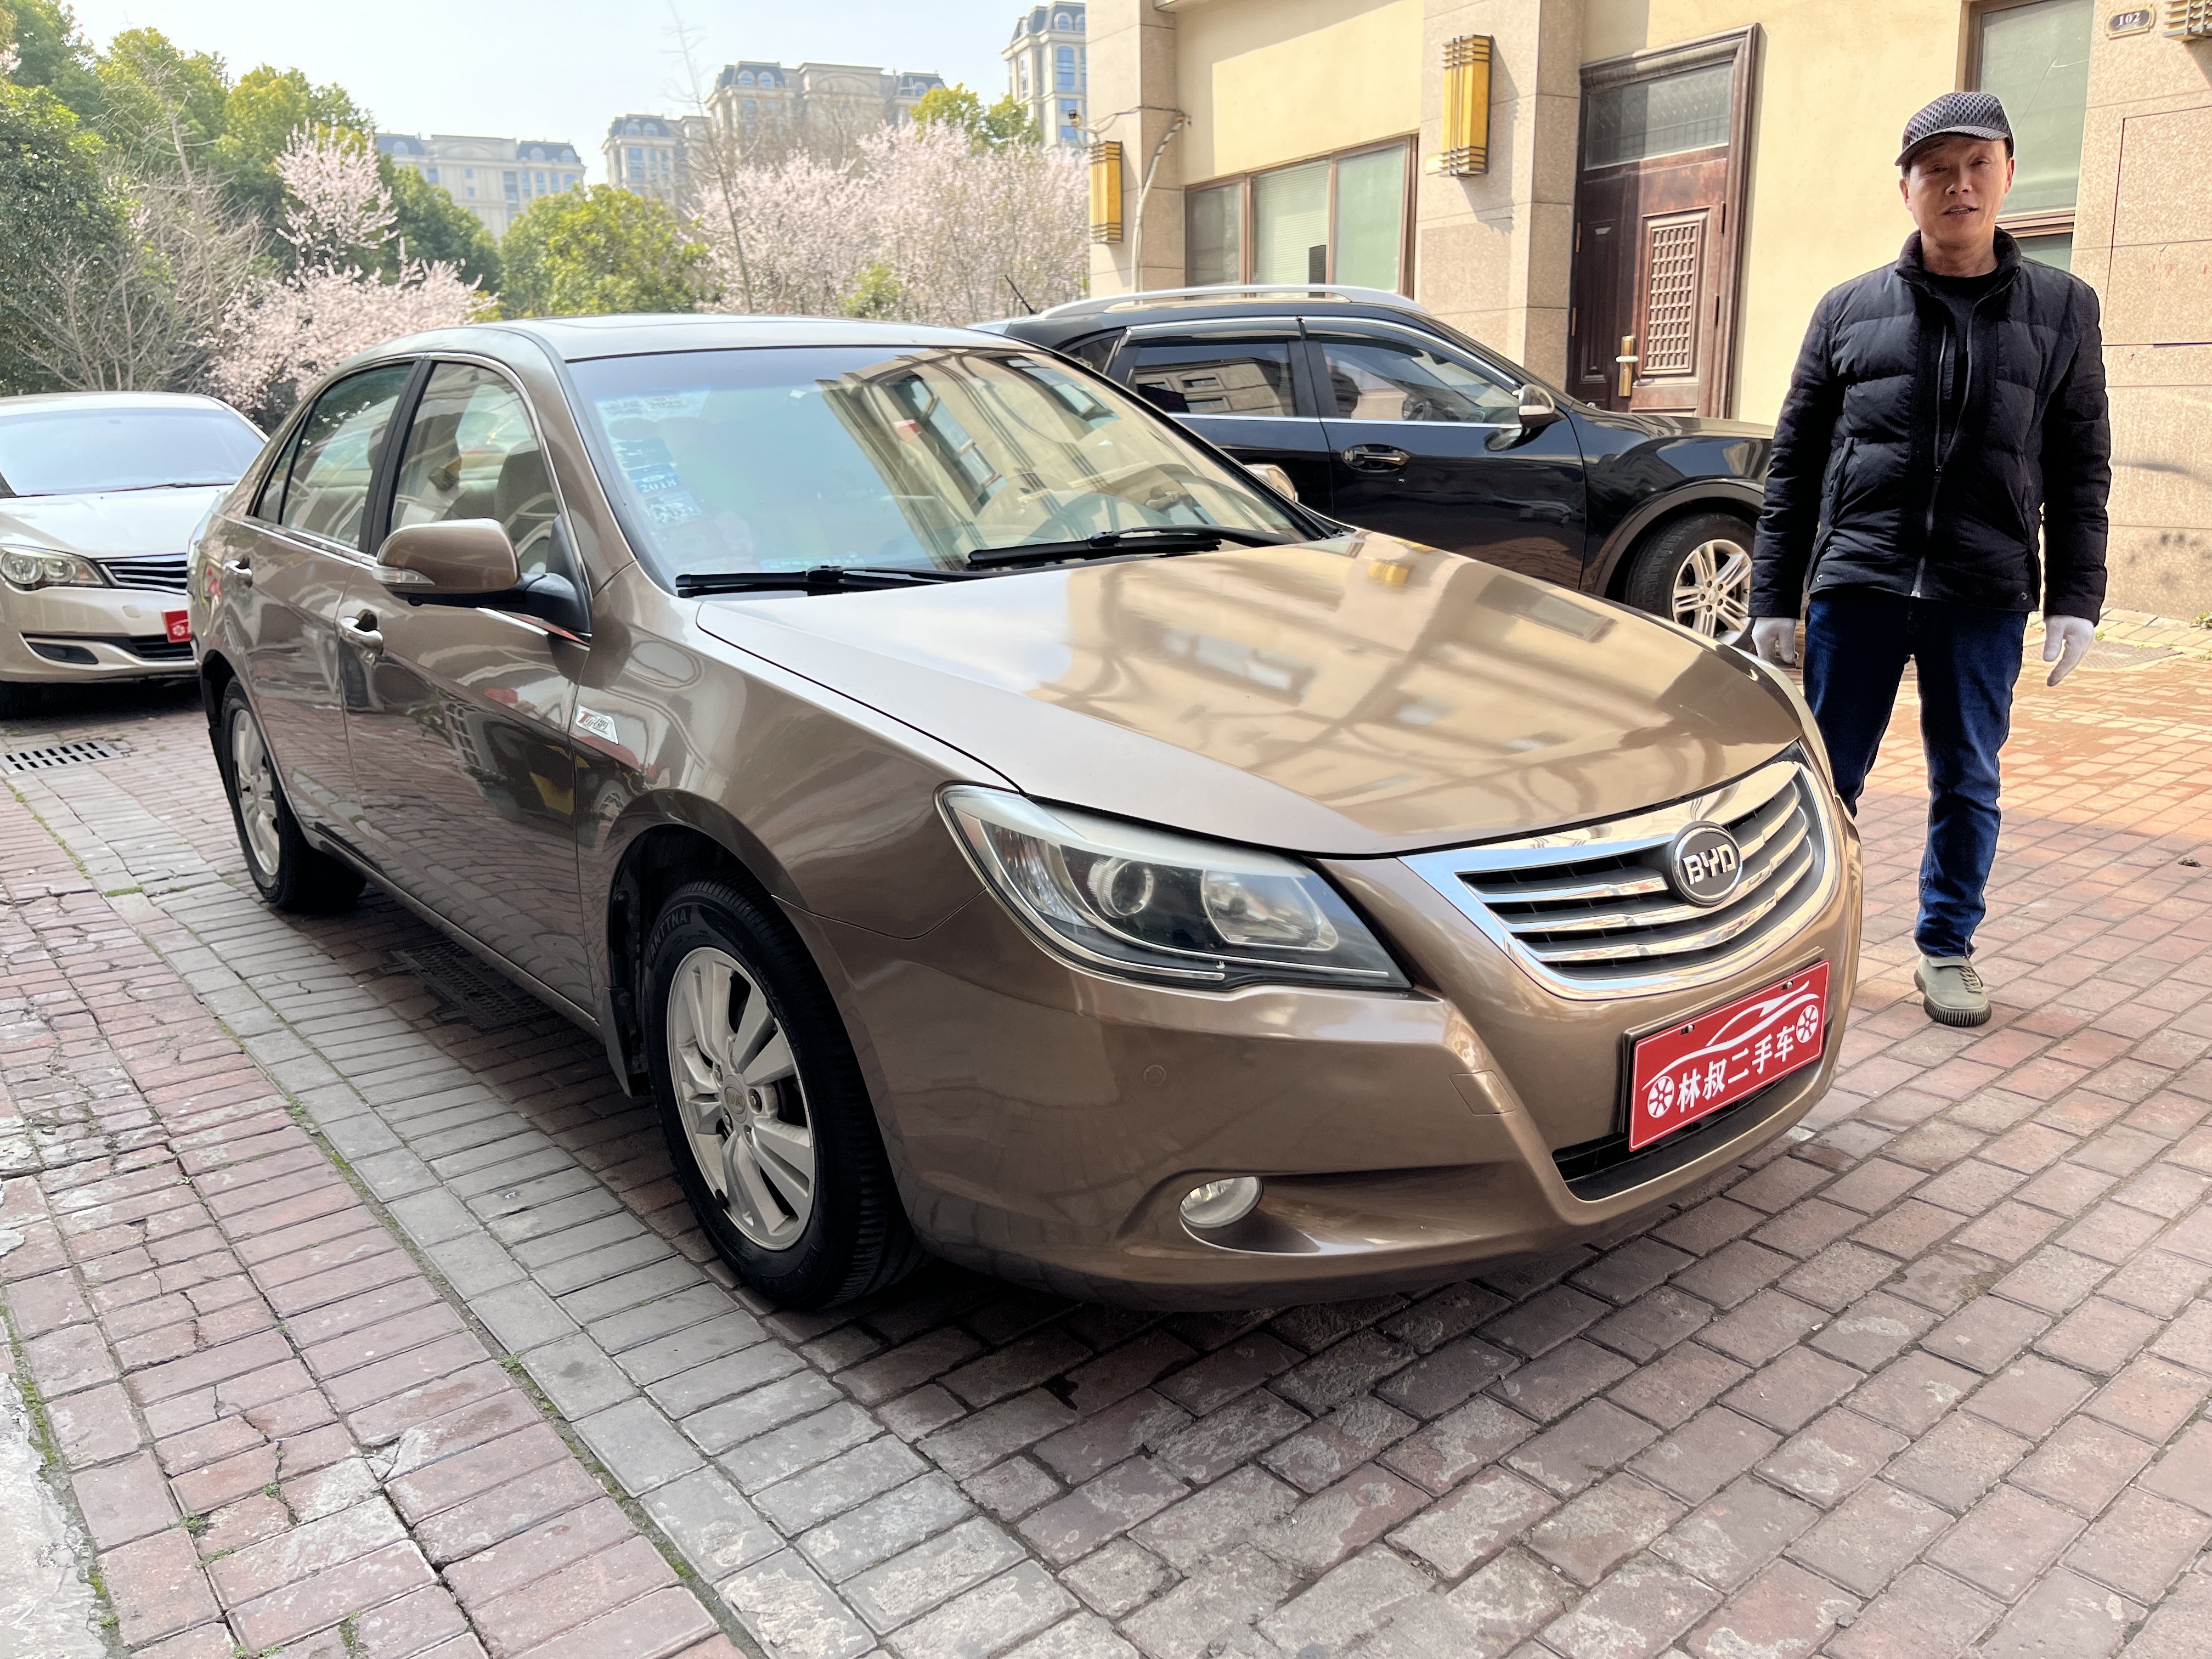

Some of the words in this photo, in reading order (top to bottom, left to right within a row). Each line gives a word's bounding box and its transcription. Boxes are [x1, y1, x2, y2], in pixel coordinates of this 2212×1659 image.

[2118, 12, 2140, 25] 102
[639, 479, 677, 493] 2018
[1683, 844, 1736, 885] BYD
[1676, 1025, 1795, 1113] 林叔二手车
